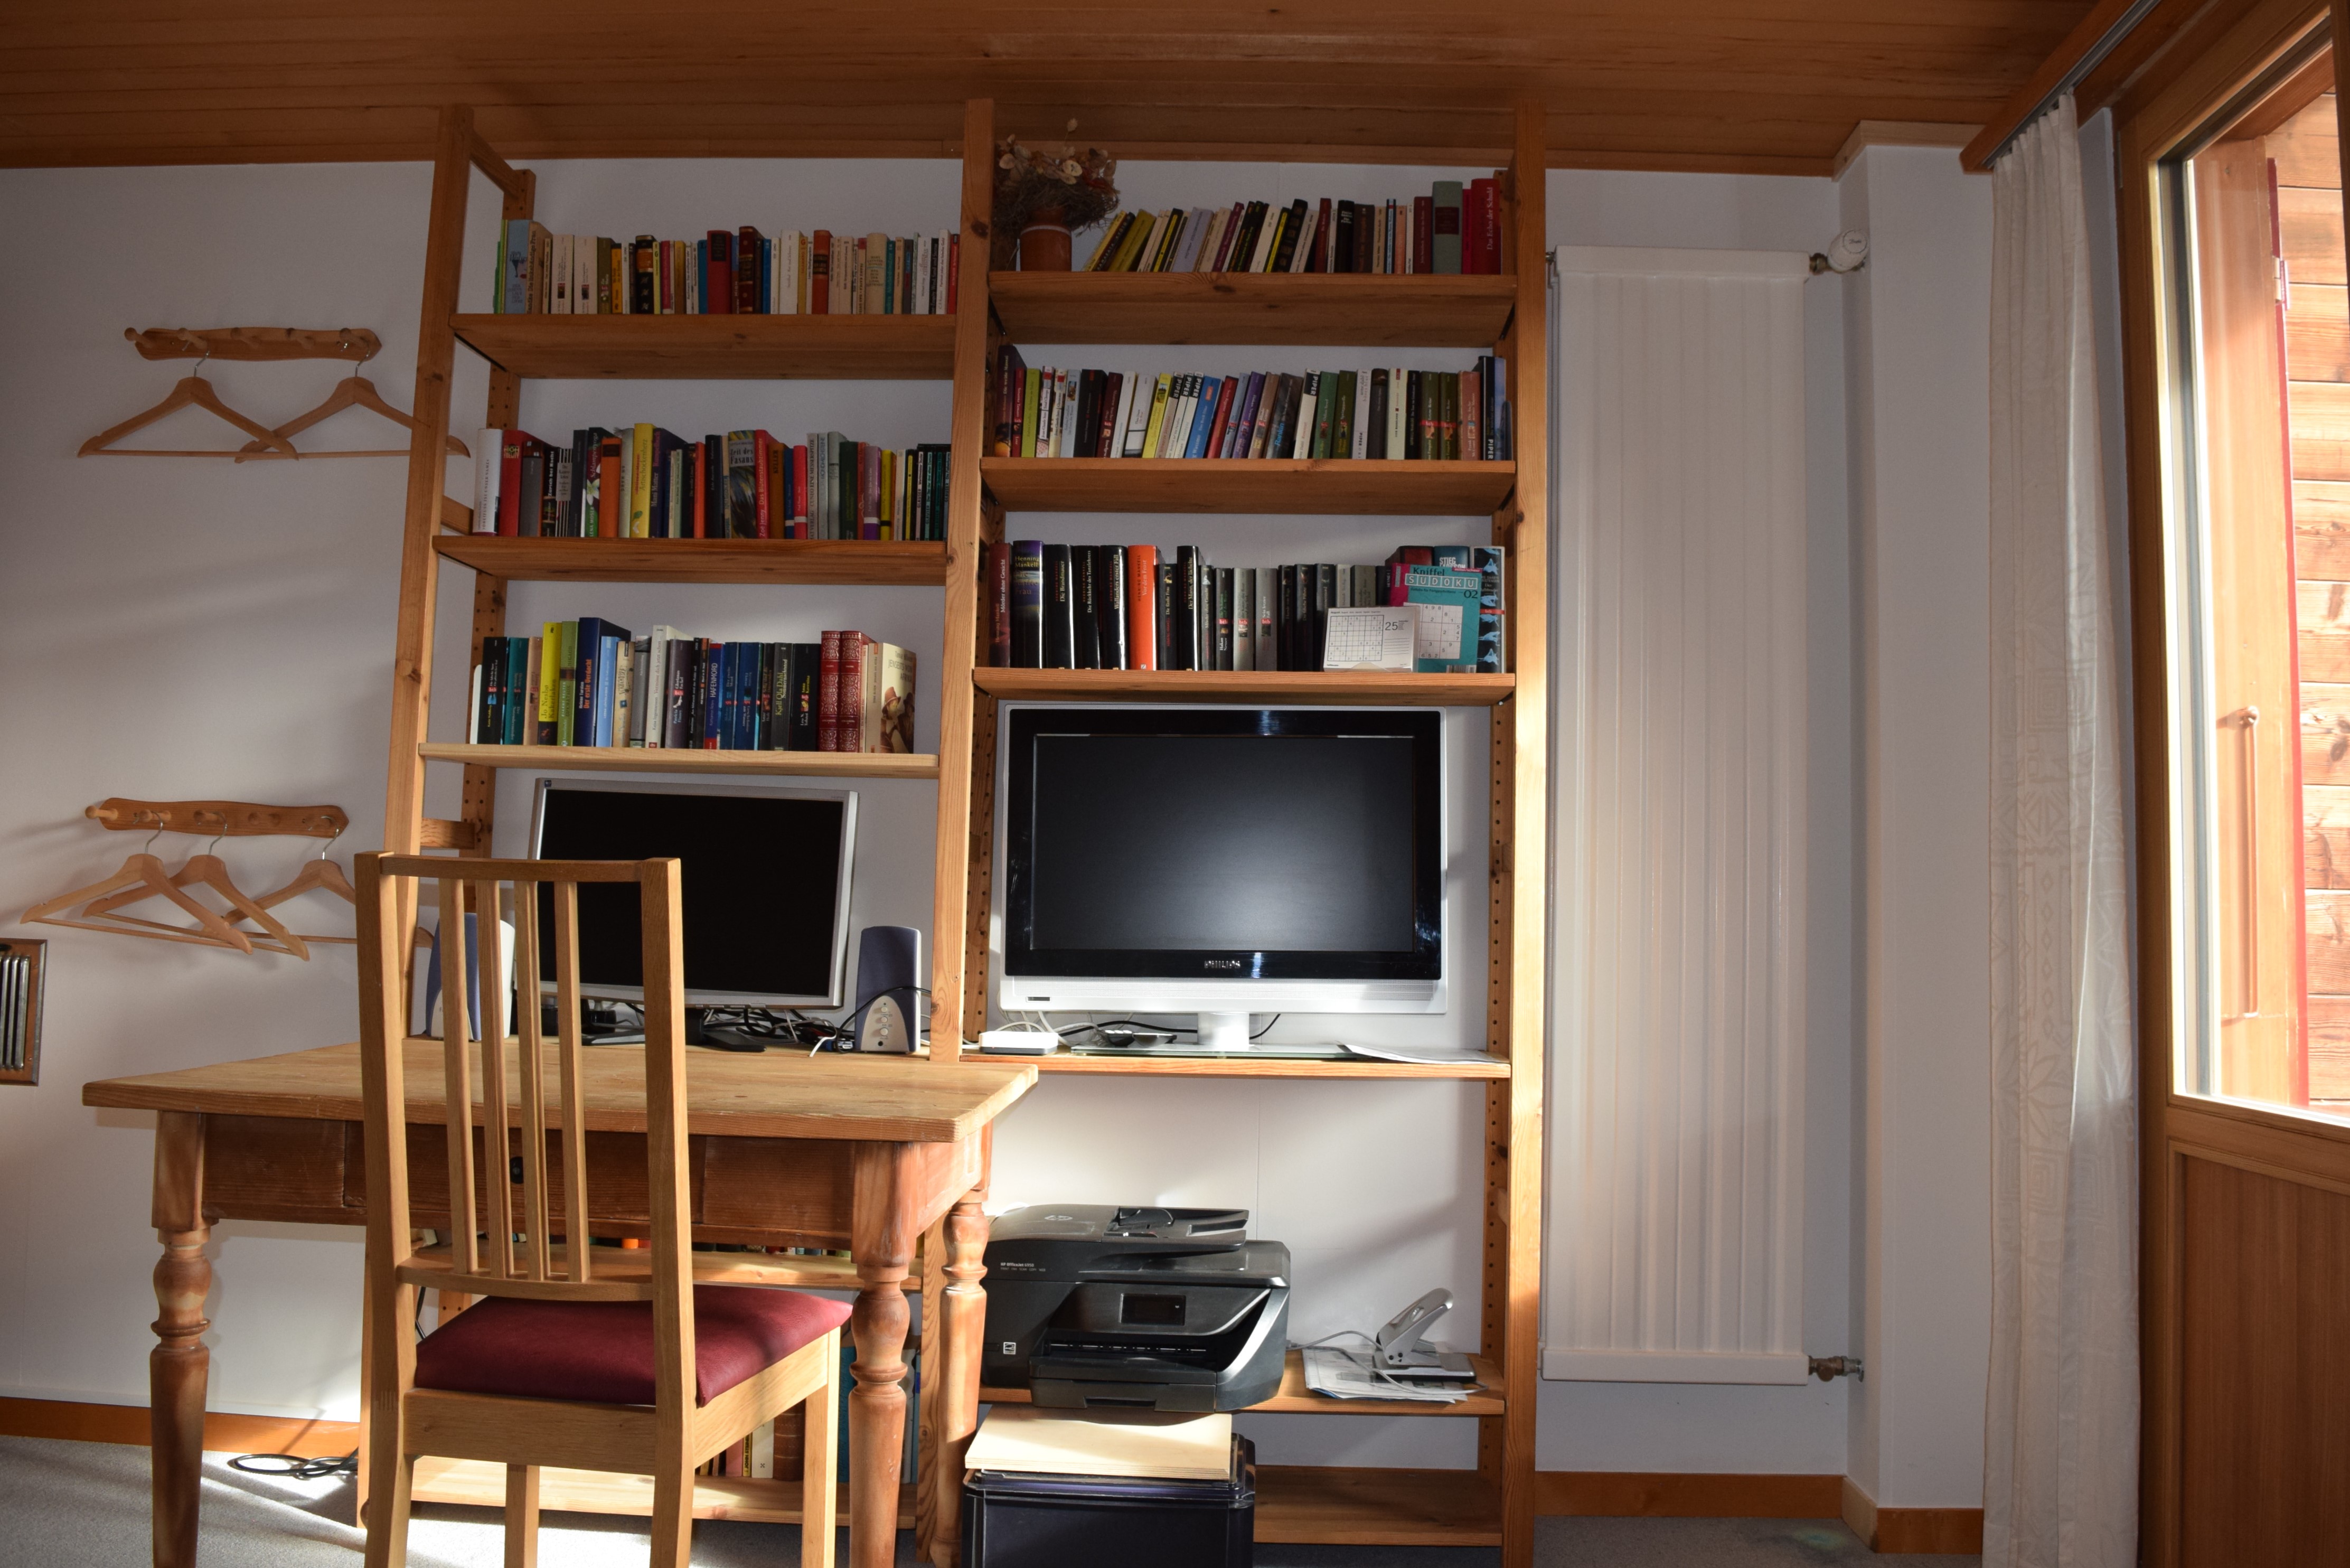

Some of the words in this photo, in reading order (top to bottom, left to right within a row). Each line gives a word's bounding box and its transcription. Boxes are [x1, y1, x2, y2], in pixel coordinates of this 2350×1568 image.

[1173, 379, 1182, 398] PIPER
[1183, 377, 1192, 396] PIPER
[1192, 379, 1201, 398] PIPER
[1310, 376, 1319, 395] PIPER
[1274, 422, 1285, 446] Rankin
[759, 509, 768, 525] Jenny
[1413, 567, 1445, 576] Kniffel
[1409, 576, 1474, 587] SUDOKU
[1464, 590, 1478, 599] 02
[1385, 622, 1398, 631] 25
[541, 709, 548, 719] Jo
[1205, 961, 1241, 969] PHILIPS
